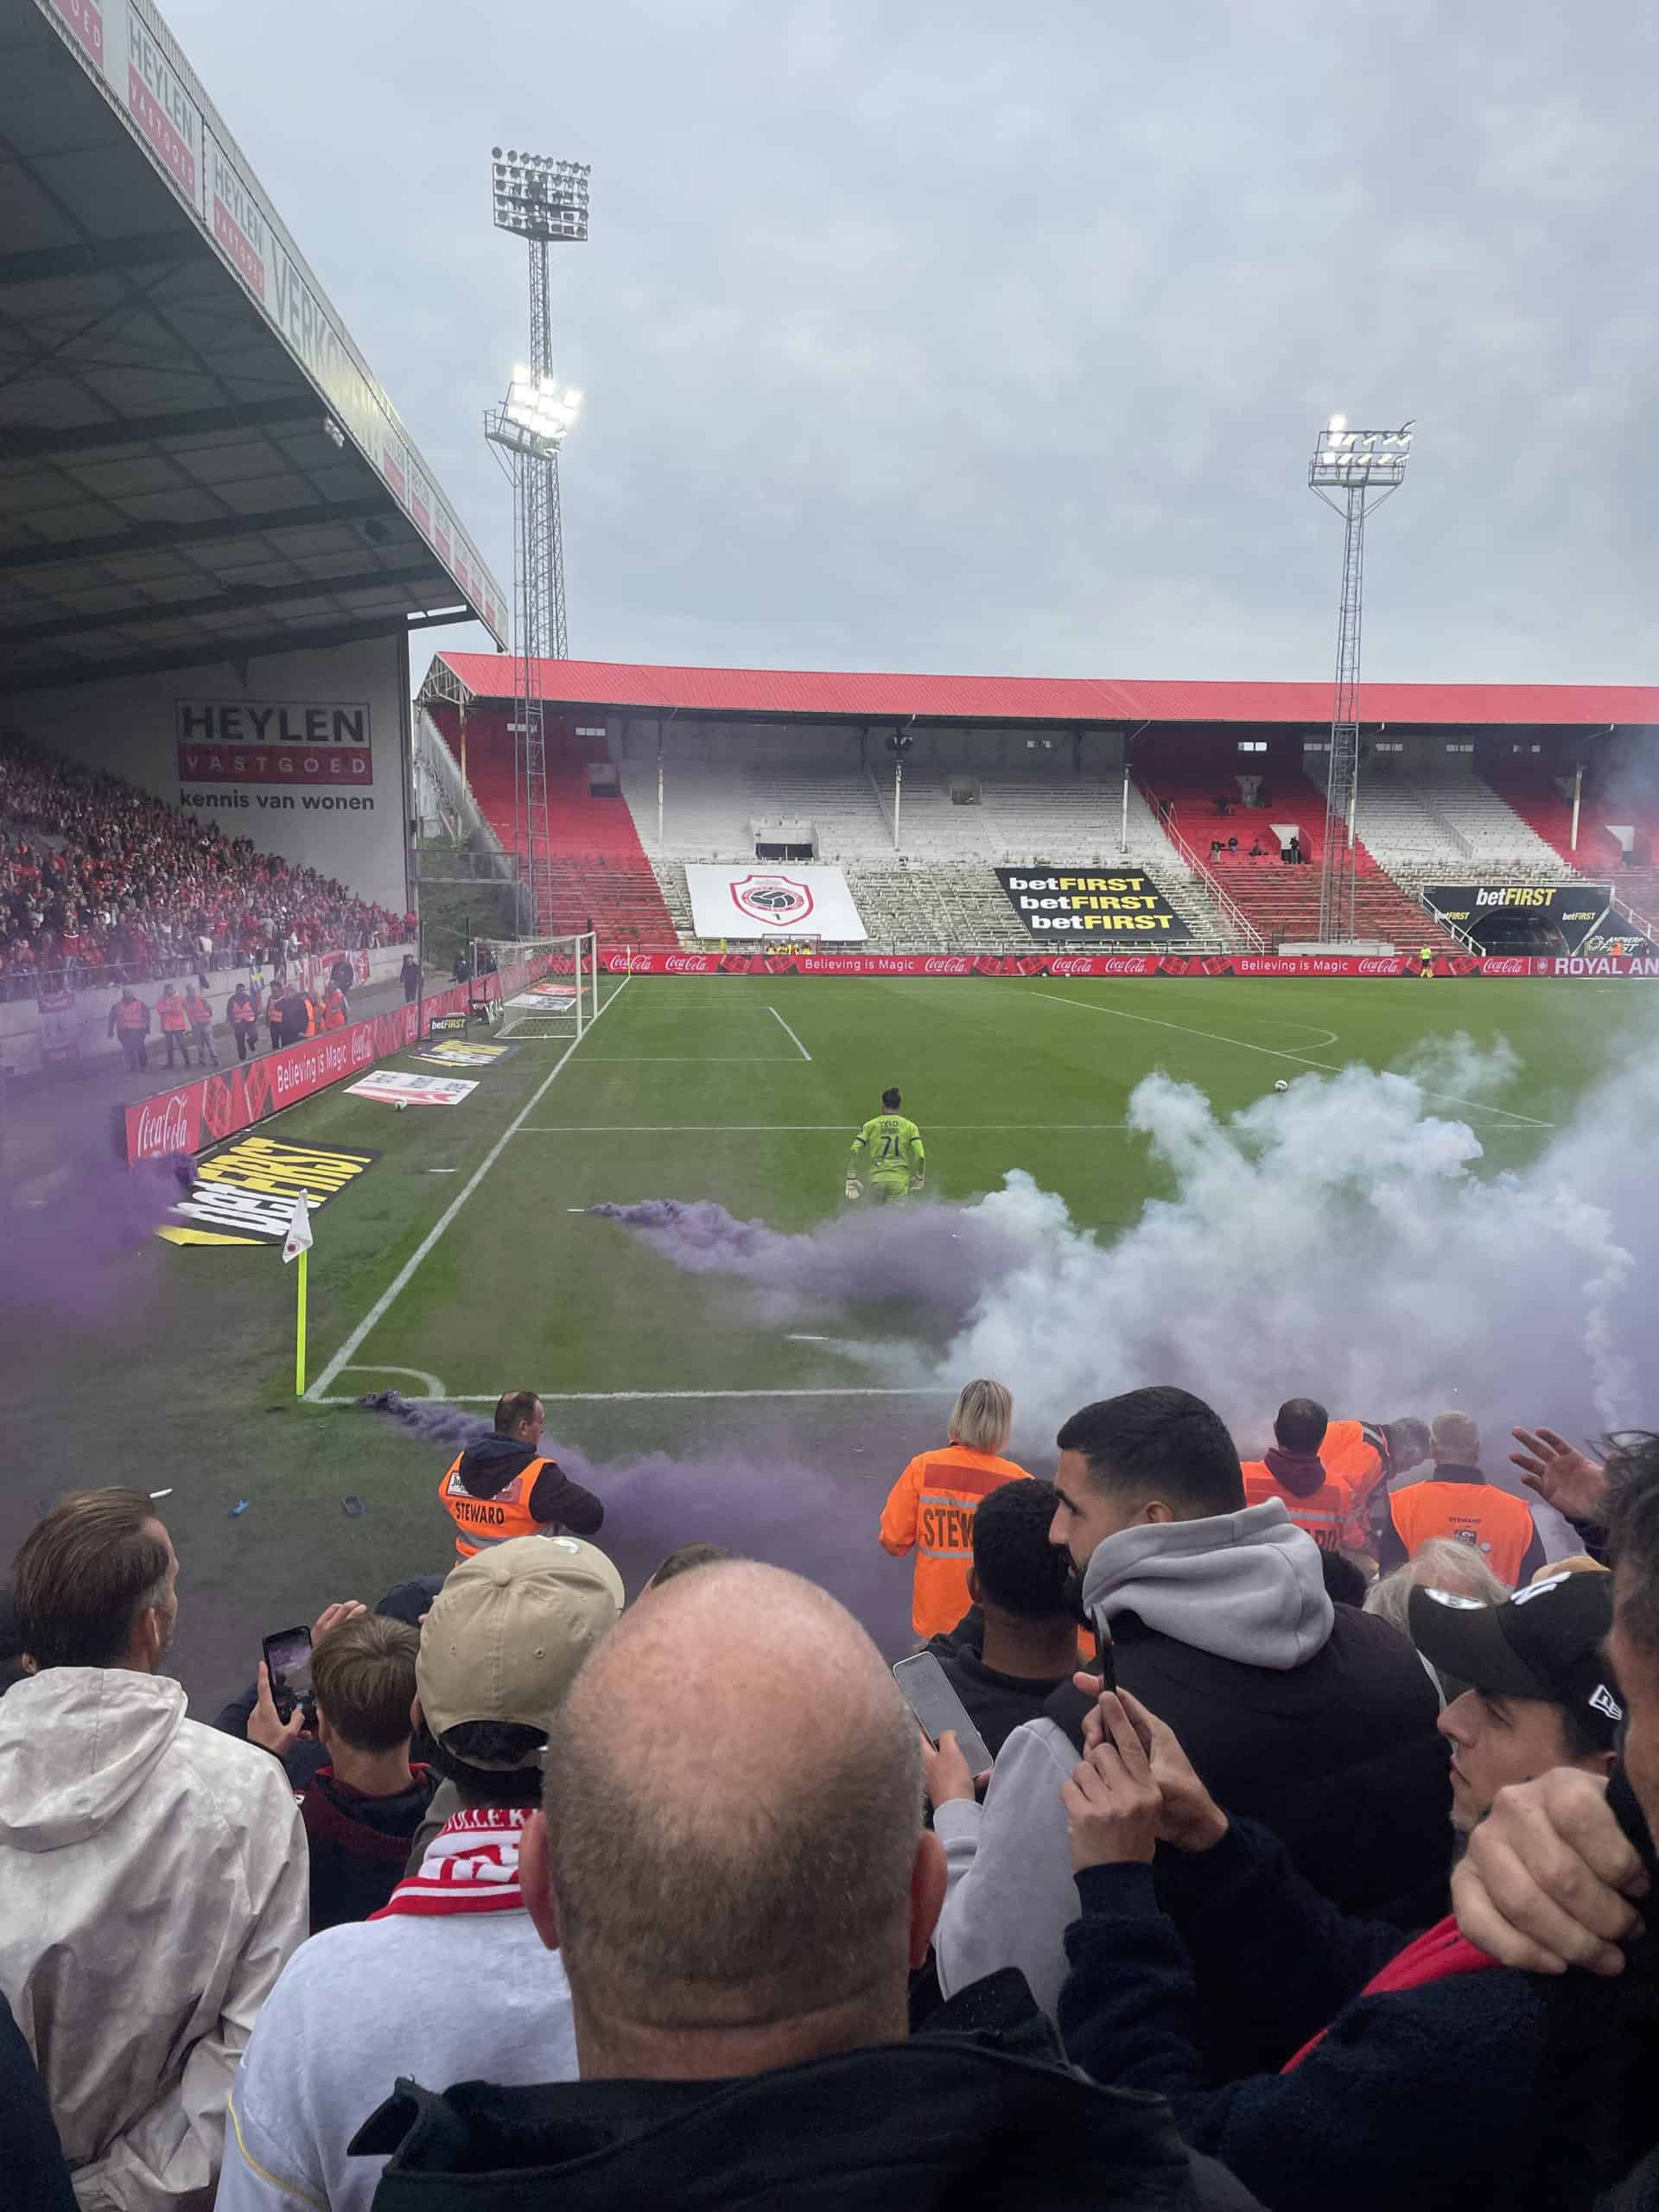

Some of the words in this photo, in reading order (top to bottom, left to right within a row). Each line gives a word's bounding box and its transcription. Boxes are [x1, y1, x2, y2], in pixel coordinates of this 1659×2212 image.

[130, 24, 194, 148] HEYLEN
[216, 154, 262, 254] HEYLEN
[181, 706, 365, 741] HEYLEN
[187, 754, 366, 774] VASTGOED
[180, 788, 250, 809] kennis
[257, 795, 295, 810] van
[302, 796, 374, 810] wonen
[1009, 877, 1145, 891] betFIRST
[1020, 895, 1159, 910] betFIRST
[1476, 888, 1556, 906] betFIRST
[1032, 914, 1173, 930] betFIRST
[805, 959, 861, 972] Believing
[864, 959, 874, 970] is
[880, 959, 913, 971] Magic
[1242, 960, 1295, 973] Believing
[1300, 960, 1309, 971] is
[1313, 960, 1348, 972] Magic
[1555, 957, 1624, 976] ROYAL
[431, 1019, 467, 1030] betFIRST
[277, 1060, 316, 1094] Believing
[317, 1051, 327, 1073] is
[880, 1135, 899, 1160] 71
[455, 1502, 505, 1525] STEWARD
[924, 1508, 975, 1548] STEW
